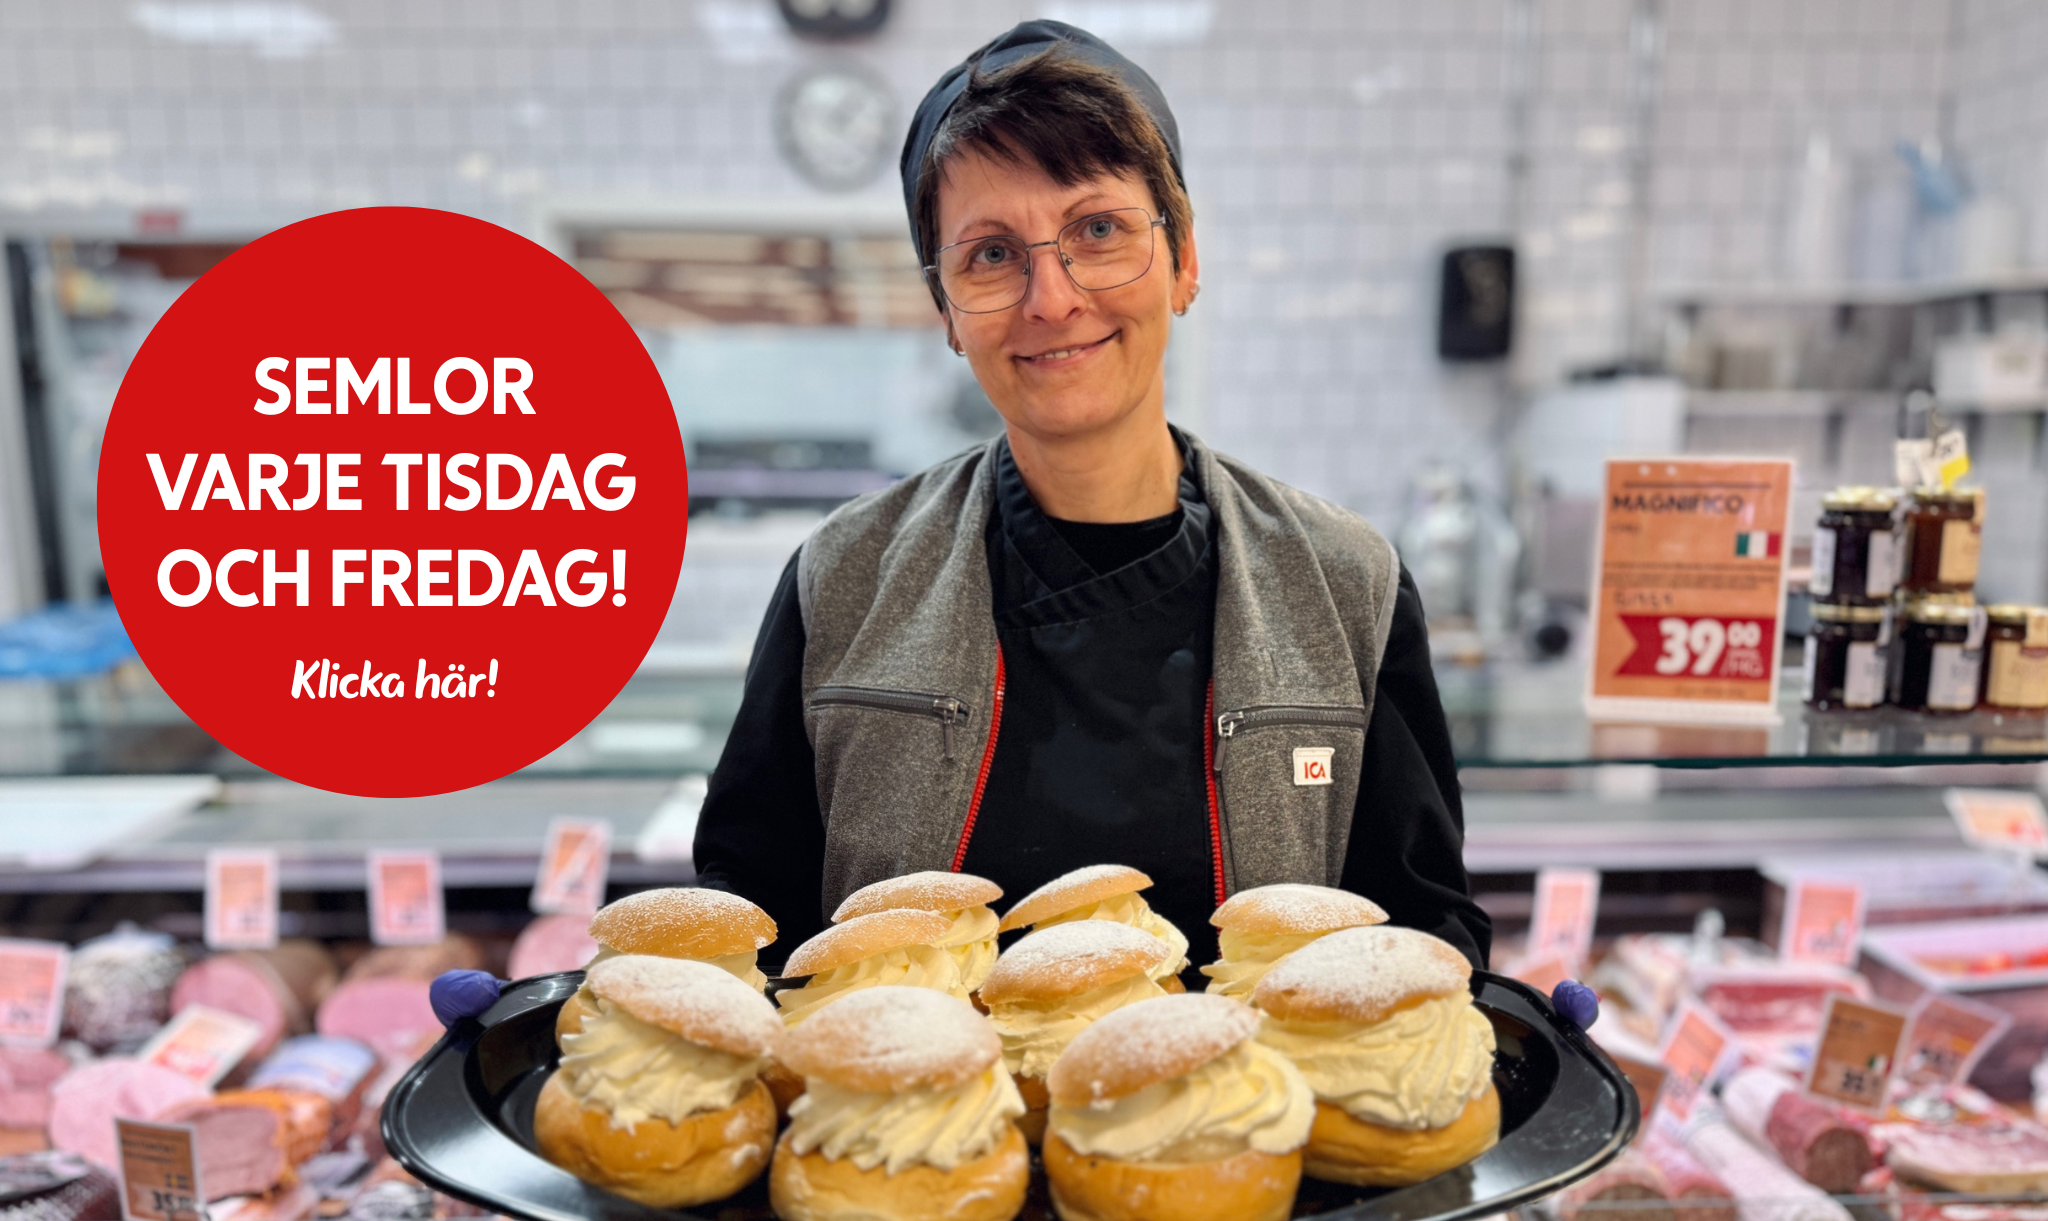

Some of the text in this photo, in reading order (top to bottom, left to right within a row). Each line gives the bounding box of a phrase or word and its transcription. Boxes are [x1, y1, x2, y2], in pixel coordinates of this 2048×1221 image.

[1612, 494, 1744, 514] MAGNIFICO
[1655, 617, 1726, 676] 39
[1304, 761, 1326, 779] ICA
